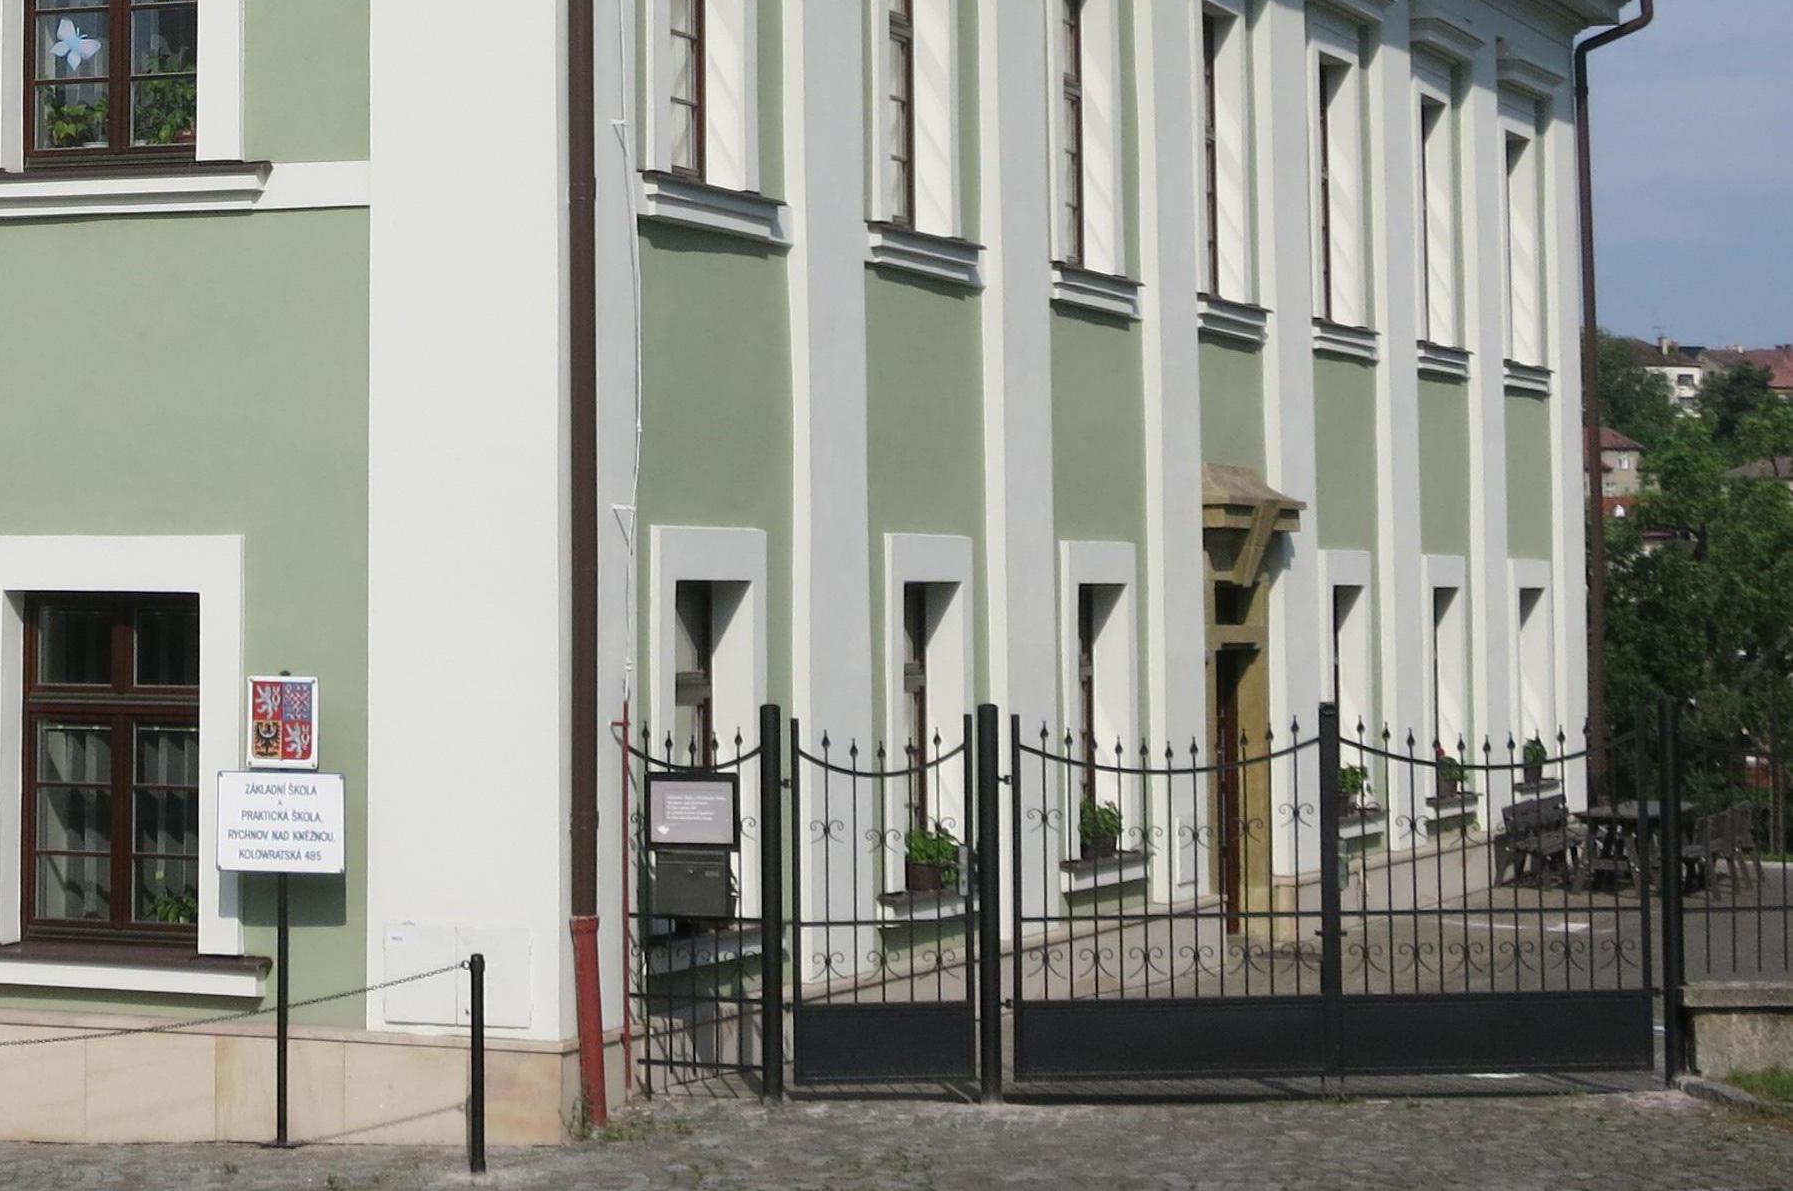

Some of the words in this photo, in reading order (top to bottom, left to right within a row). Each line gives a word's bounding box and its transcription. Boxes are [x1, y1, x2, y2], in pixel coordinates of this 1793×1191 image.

[245, 782, 286, 795] ZÁKLADNÍ
[288, 783, 317, 796] ŠKOLA
[241, 809, 289, 822] PRAKTICKÁ
[228, 829, 269, 841] RYCHNOV
[271, 830, 290, 841] NAD
[239, 848, 302, 861] KOLOWRATSKÁ
